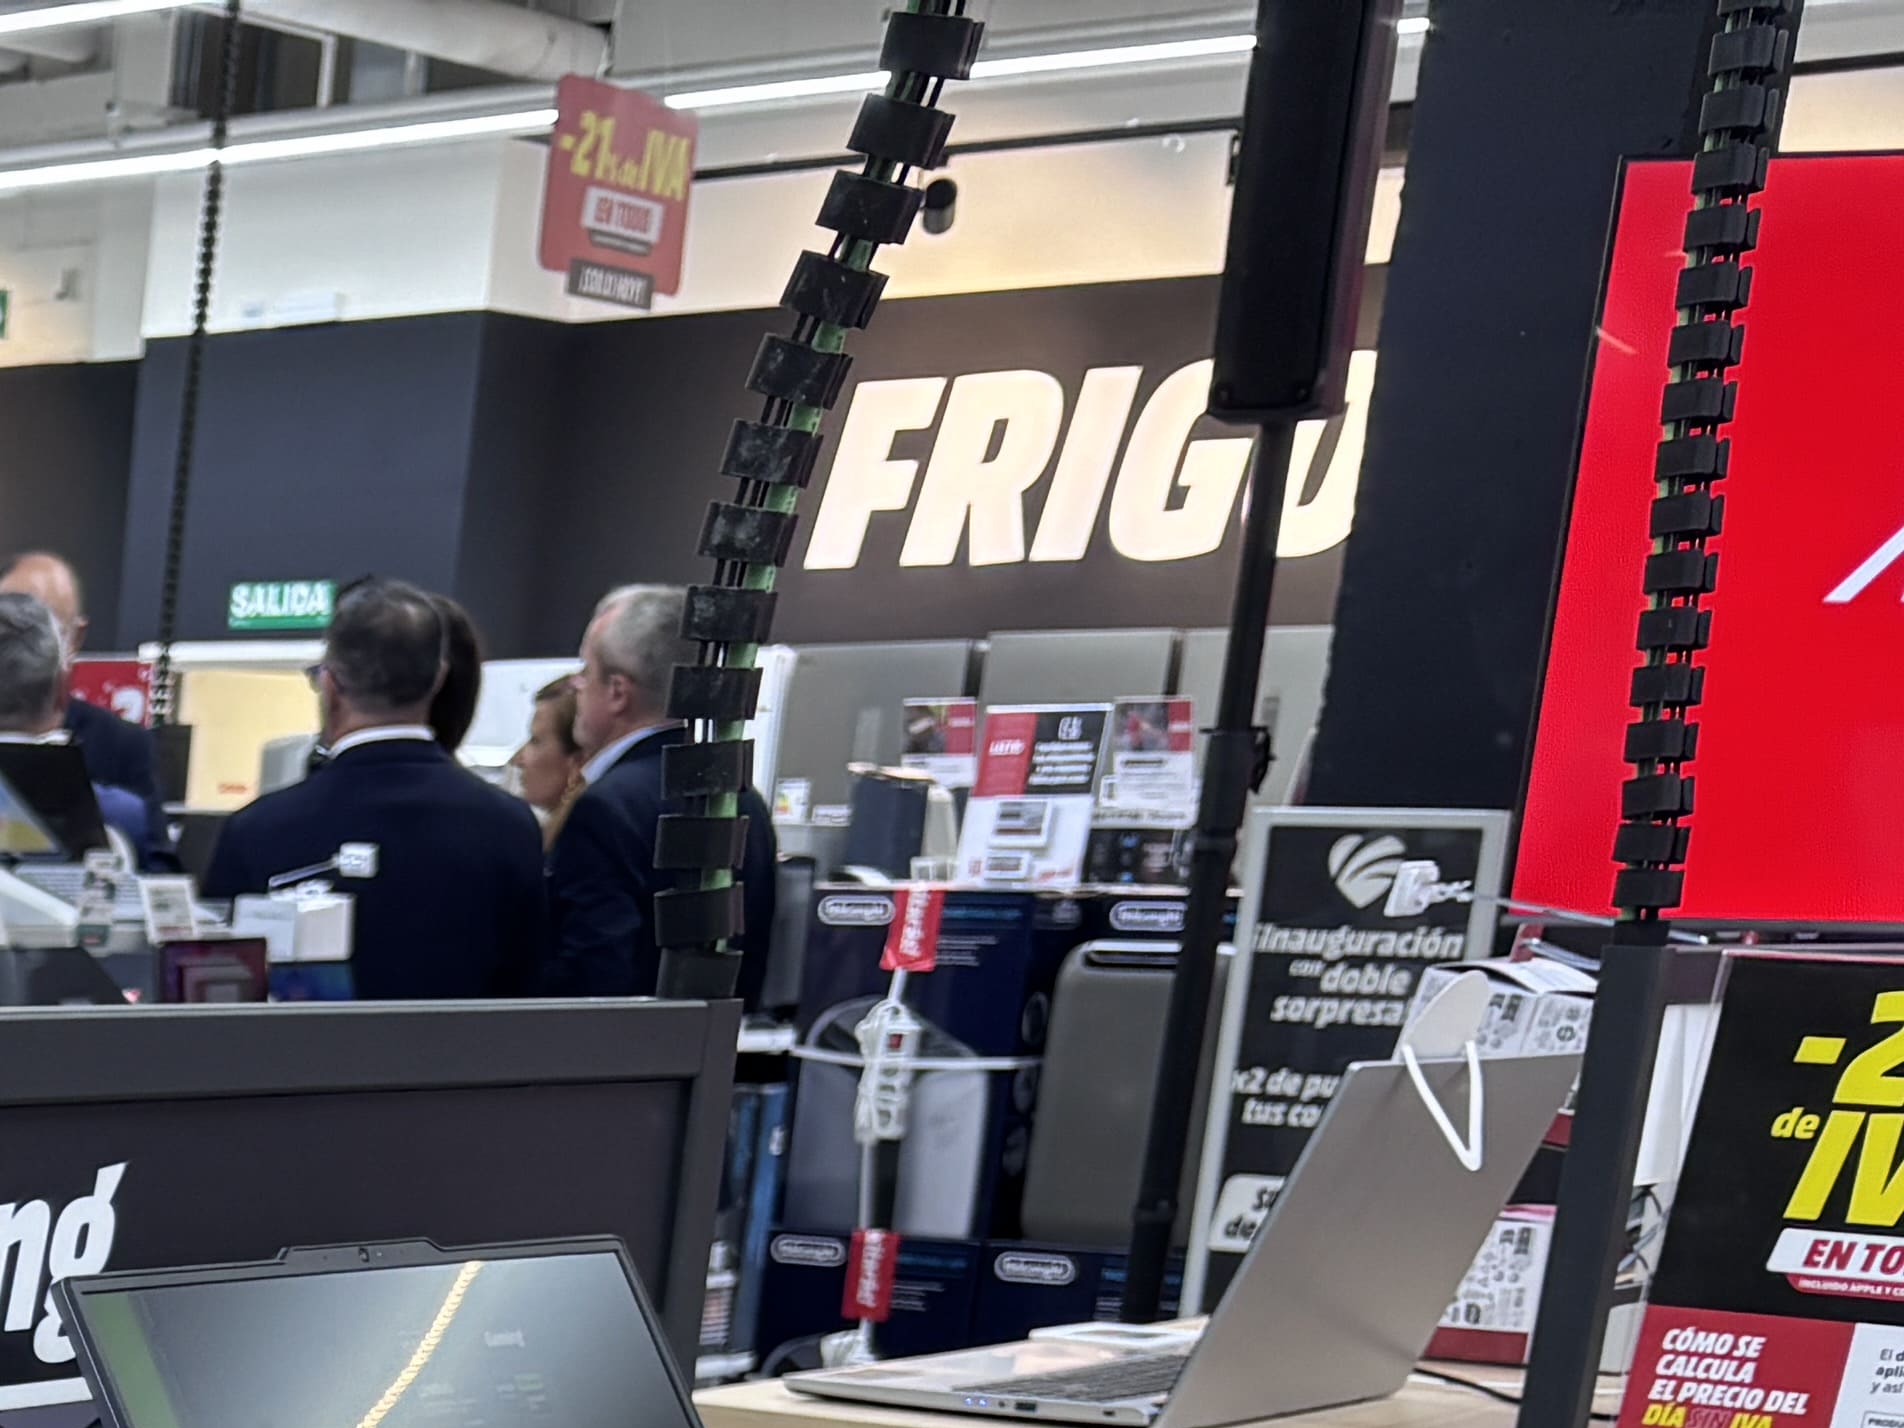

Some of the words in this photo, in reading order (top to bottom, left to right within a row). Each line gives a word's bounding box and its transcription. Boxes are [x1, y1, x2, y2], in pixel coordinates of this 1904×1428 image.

[229, 581, 331, 619] SALIDA
[1320, 962, 1412, 997] doble
[1770, 1106, 1820, 1140] de
[1802, 1237, 1858, 1271] EN
[1660, 1325, 1735, 1357] CÓMO
[1732, 1335, 1768, 1359] SE
[1880, 1348, 1895, 1362] El
[1654, 1353, 1759, 1385] CALCULA
[1647, 1378, 1678, 1403] EL
[1675, 1381, 1765, 1412] PRECIO
[1762, 1390, 1811, 1416] DEL
